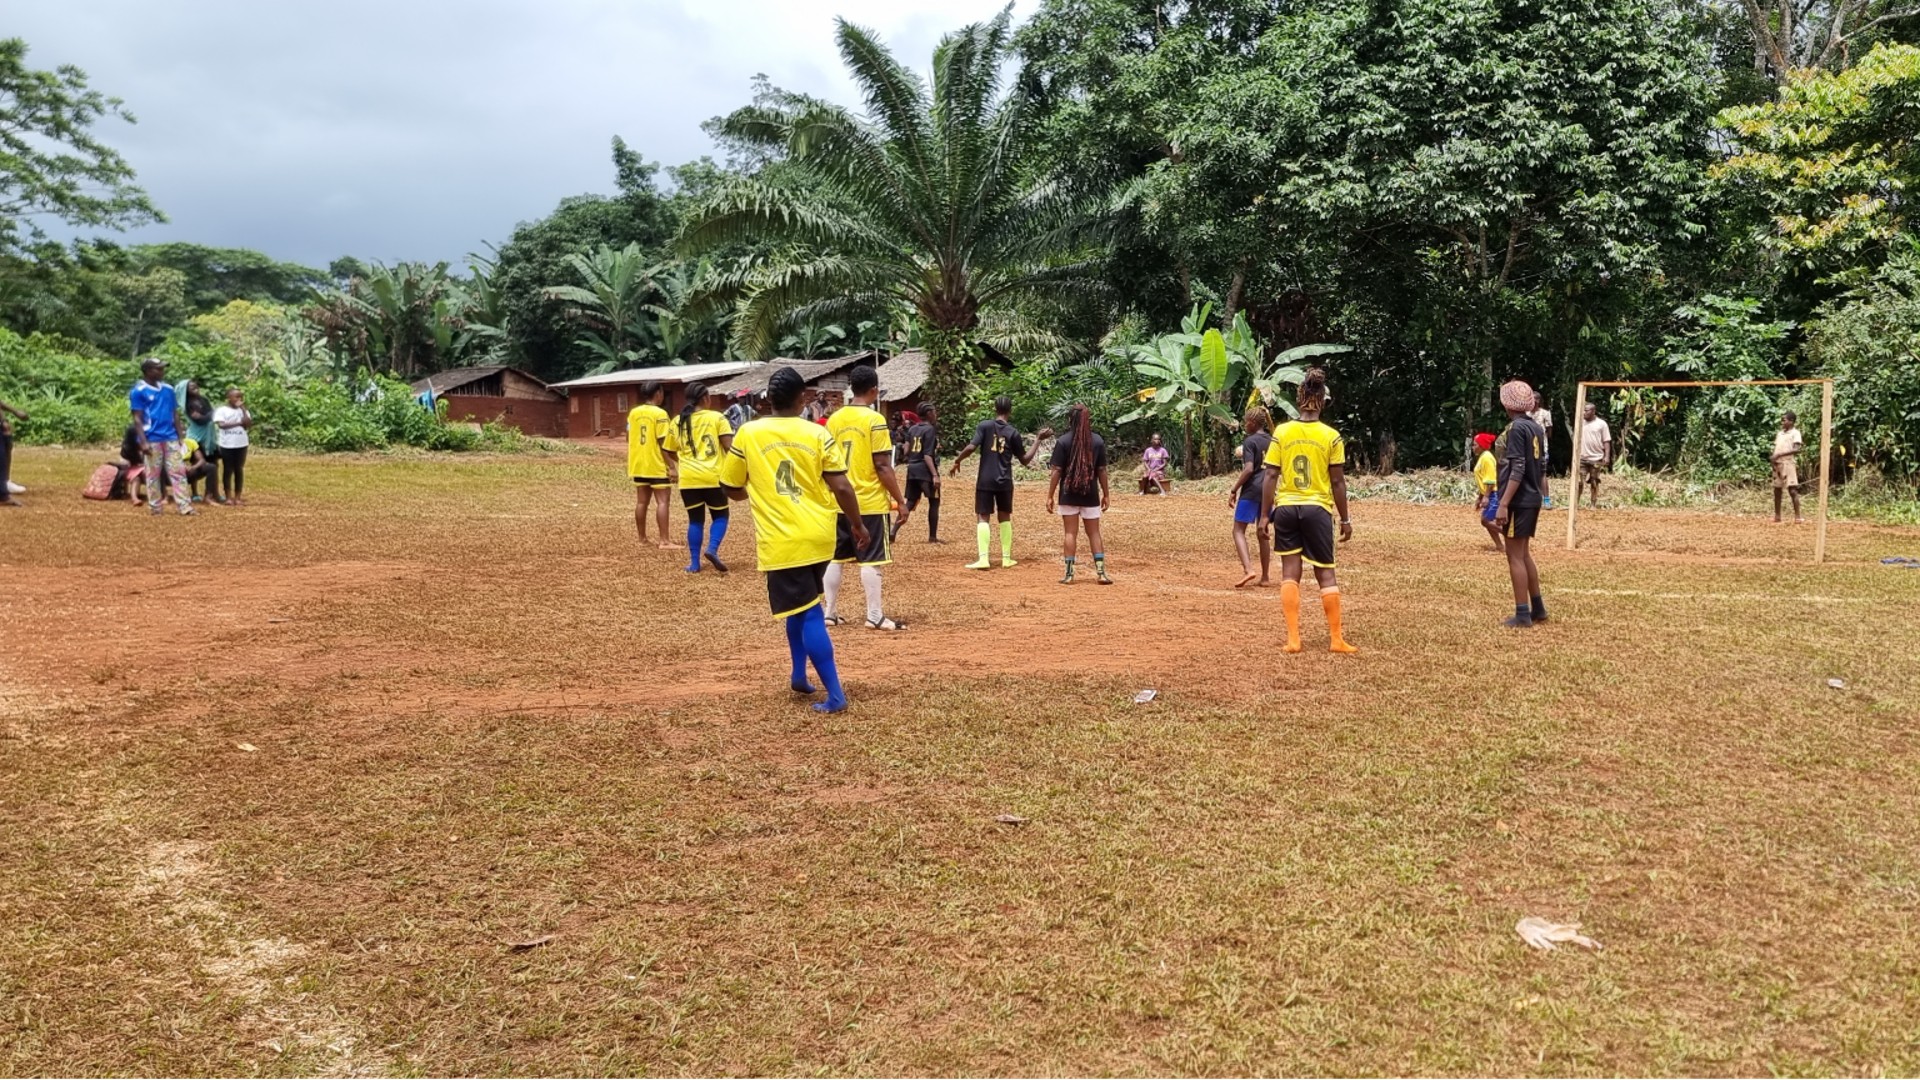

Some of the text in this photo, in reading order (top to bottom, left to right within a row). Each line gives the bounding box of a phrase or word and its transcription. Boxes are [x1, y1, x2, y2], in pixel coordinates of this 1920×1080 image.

[640, 425, 647, 446] 6
[842, 440, 854, 467] 7
[776, 460, 803, 504] 4
[1293, 455, 1312, 491] 9
